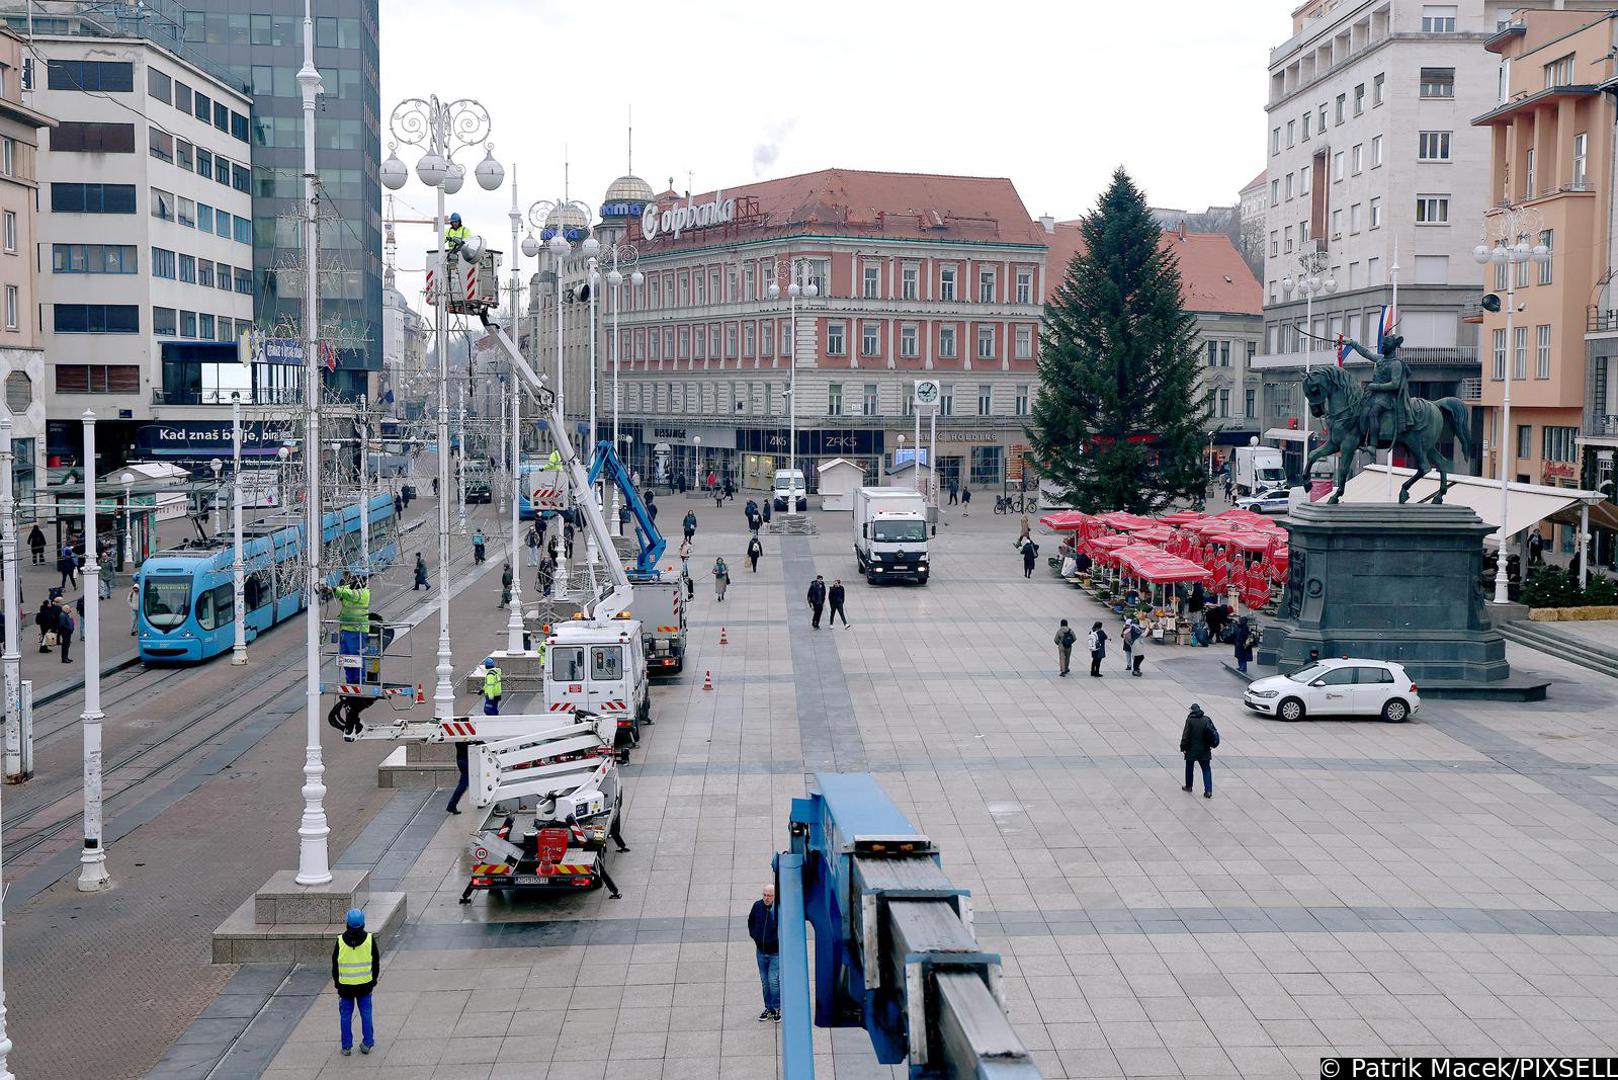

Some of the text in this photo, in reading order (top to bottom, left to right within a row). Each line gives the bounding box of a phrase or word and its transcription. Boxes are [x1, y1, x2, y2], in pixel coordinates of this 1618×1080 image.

[160, 429, 186, 440] Kad
[189, 429, 219, 440] znaš
[826, 436, 857, 447] ZAKS
